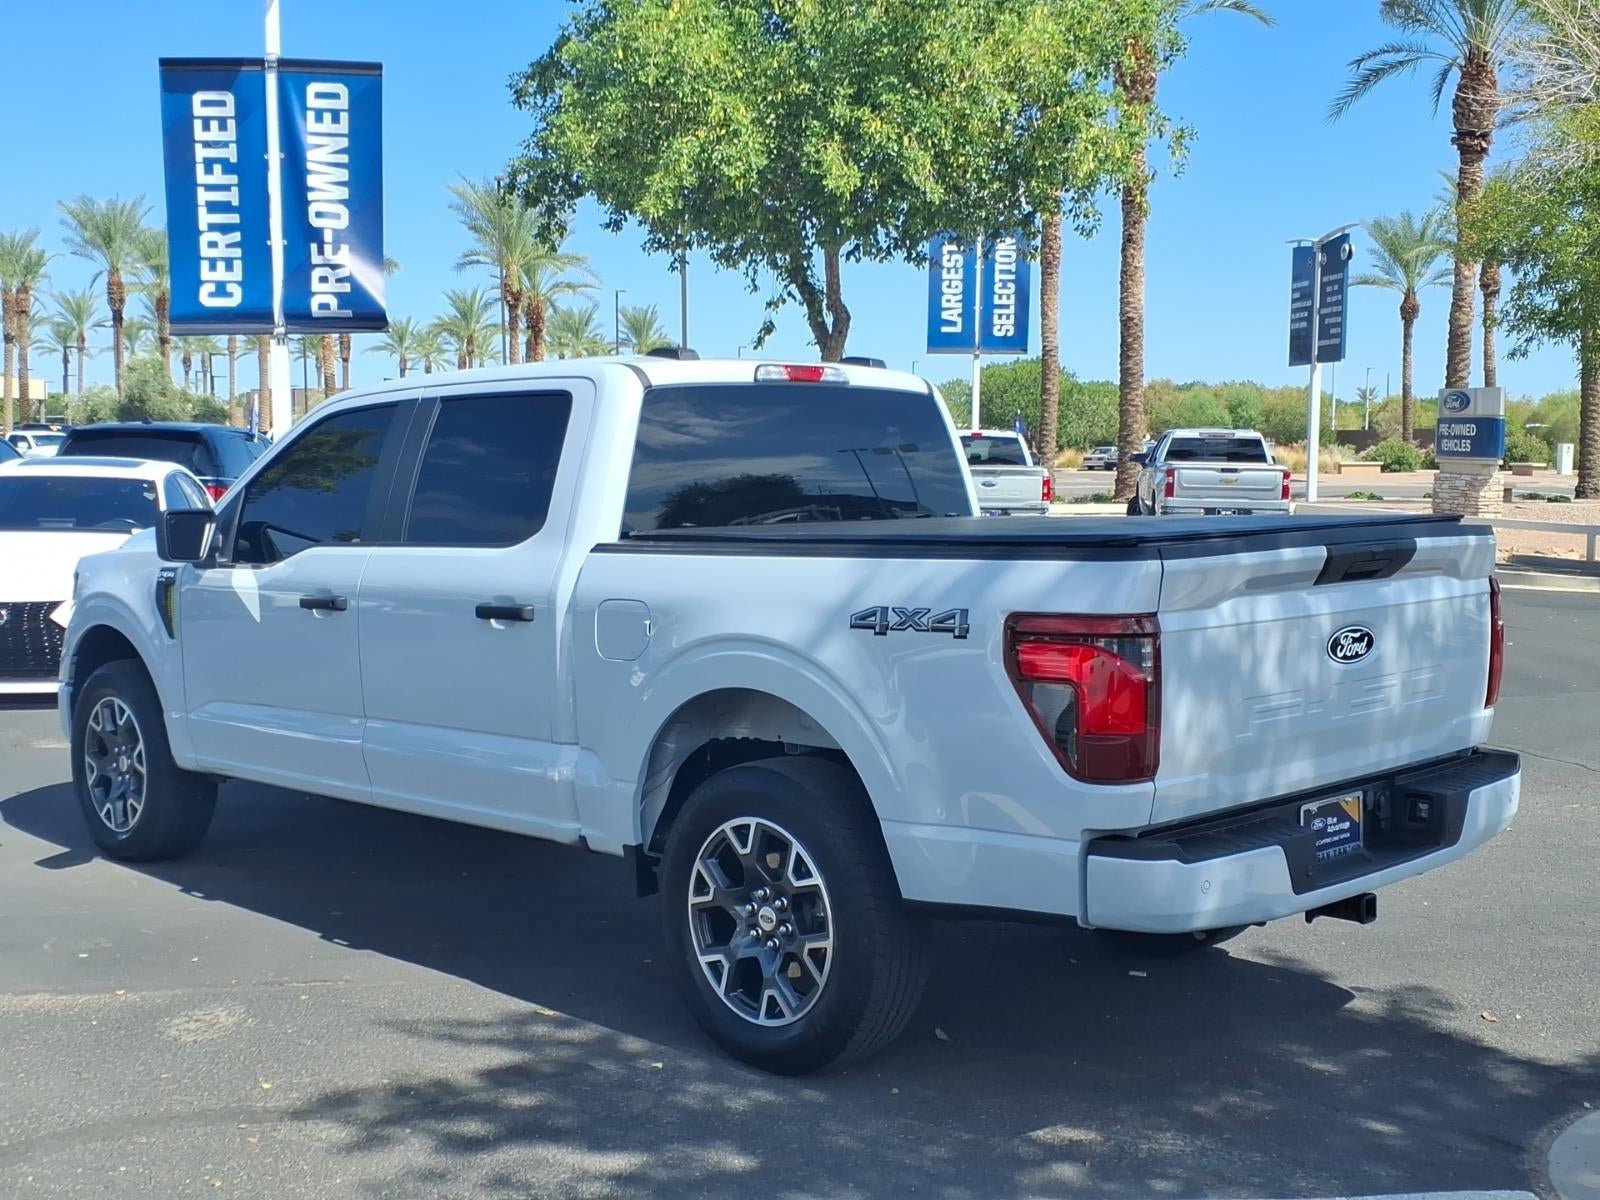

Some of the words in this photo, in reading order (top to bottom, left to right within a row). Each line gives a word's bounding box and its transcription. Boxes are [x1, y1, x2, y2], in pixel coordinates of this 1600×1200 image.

[192, 90, 243, 308] CERTIFIED
[306, 82, 352, 318] PRE-OWNED
[941, 241, 964, 333] LARGEST
[993, 237, 1017, 337] SELECTION
[1438, 423, 1477, 436] PRE-OWNED
[1441, 439, 1471, 451] VEHICLES
[1337, 632, 1368, 657] Ford
